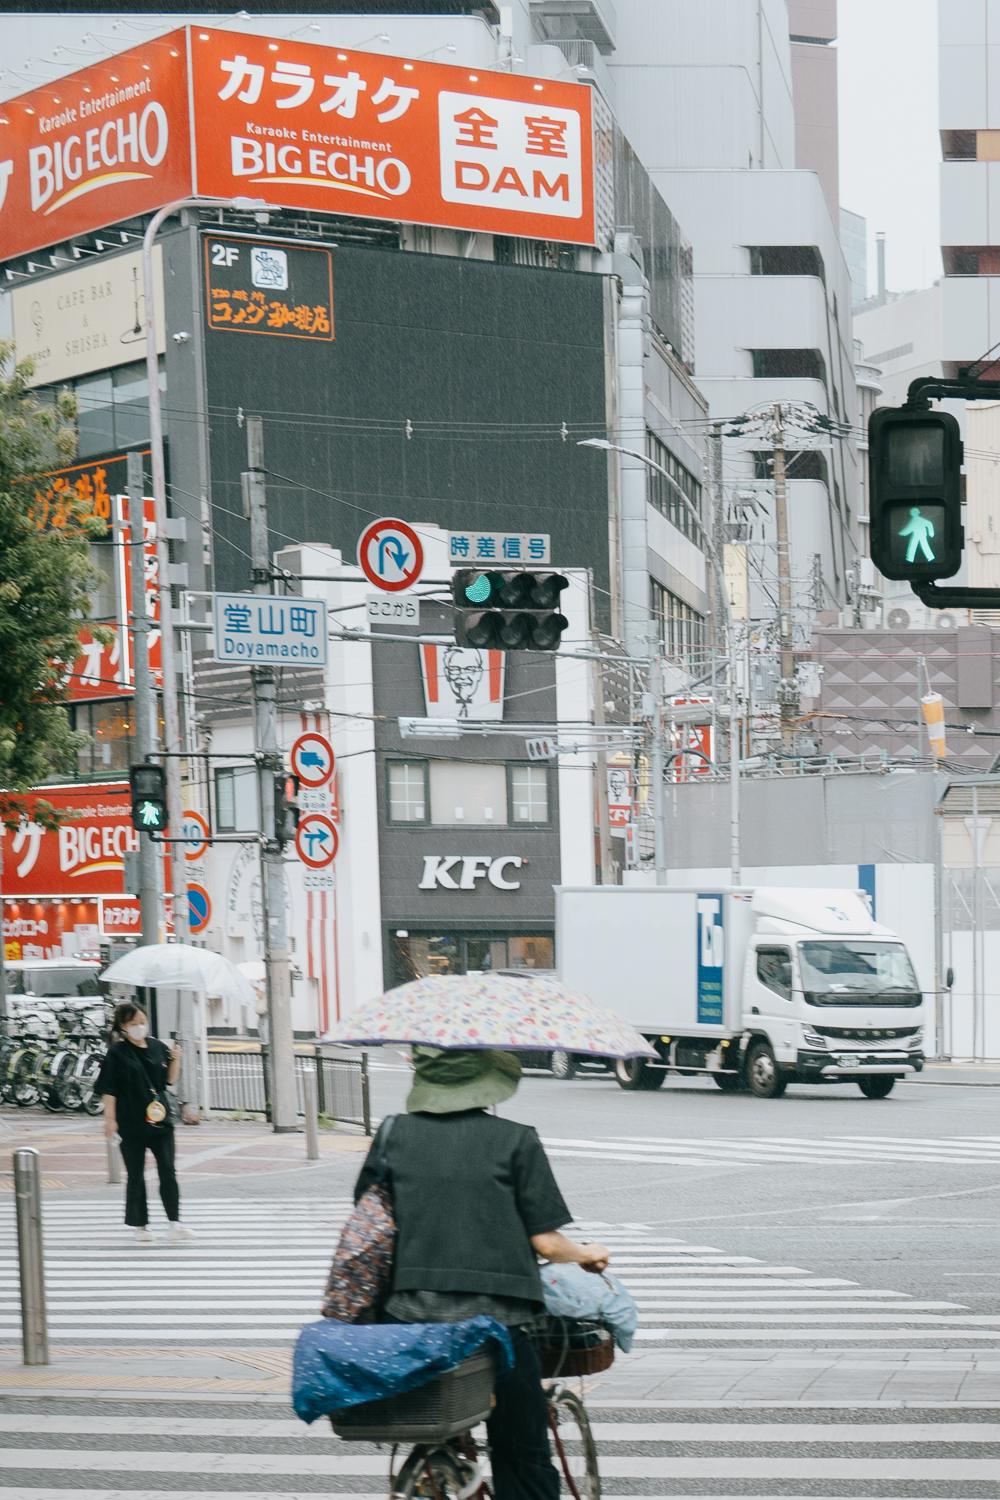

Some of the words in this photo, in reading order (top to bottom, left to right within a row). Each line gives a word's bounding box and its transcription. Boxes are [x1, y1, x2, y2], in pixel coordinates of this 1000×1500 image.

[39, 107, 77, 135] Karaoke
[79, 76, 152, 119] Entertainment
[217, 54, 420, 124] カラオケ
[246, 121, 298, 140] Karaoke
[301, 129, 393, 153] Entertainment
[453, 106, 569, 159] 全室
[29, 135, 83, 213] BIG
[85, 100, 169, 172] ECHO
[230, 135, 303, 177] BIG
[308, 149, 412, 196] ECHO
[454, 160, 570, 202] DAM
[211, 243, 240, 267] 2F
[451, 536, 547, 560] 時差信号
[224, 603, 317, 637] 堂山町
[369, 601, 416, 618] ここから
[224, 637, 320, 658] Doyamacho
[59, 825, 101, 872] BIG
[418, 855, 522, 890] KFC
